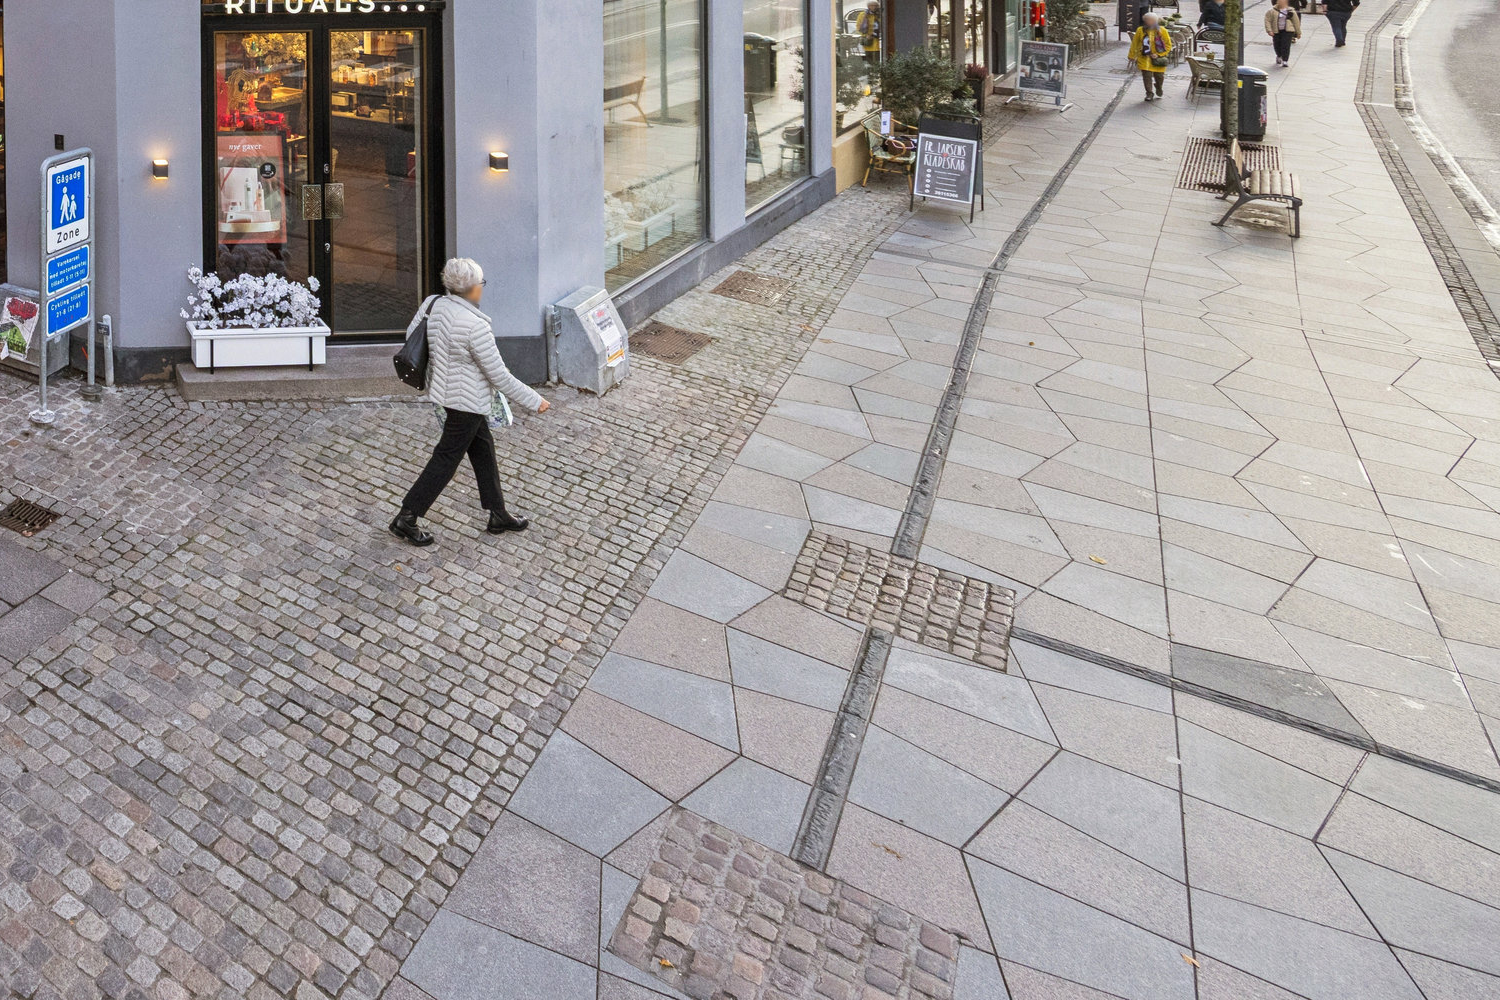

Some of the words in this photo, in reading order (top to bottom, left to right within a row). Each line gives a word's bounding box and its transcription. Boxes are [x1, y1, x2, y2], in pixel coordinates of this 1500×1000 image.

[55, 171, 81, 185] Gågade
[57, 227, 80, 244] Zone
[56, 254, 80, 267] Varekørsel
[51, 279, 65, 288] tilladt
[50, 299, 70, 312] Cykling
[70, 290, 86, 303] tilladt
